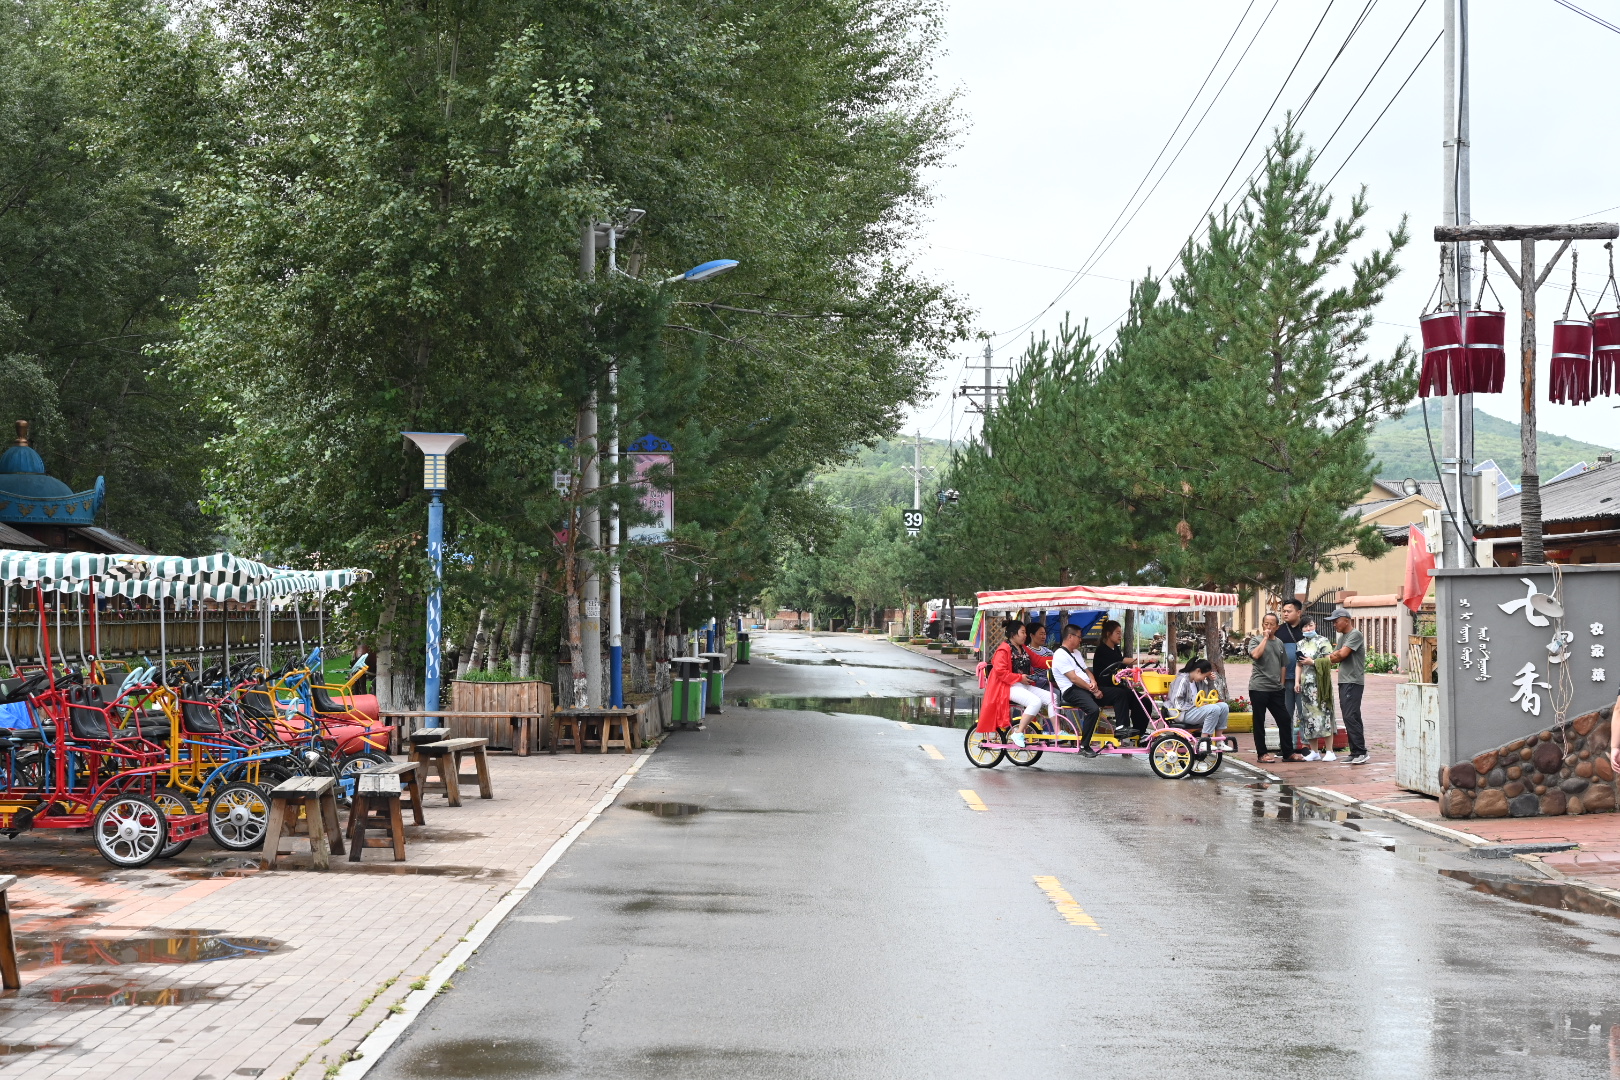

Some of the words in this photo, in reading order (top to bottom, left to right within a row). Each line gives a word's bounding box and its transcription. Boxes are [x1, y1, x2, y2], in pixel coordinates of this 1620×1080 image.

[904, 512, 923, 527] 39
[1590, 622, 1606, 682] 农家菜
